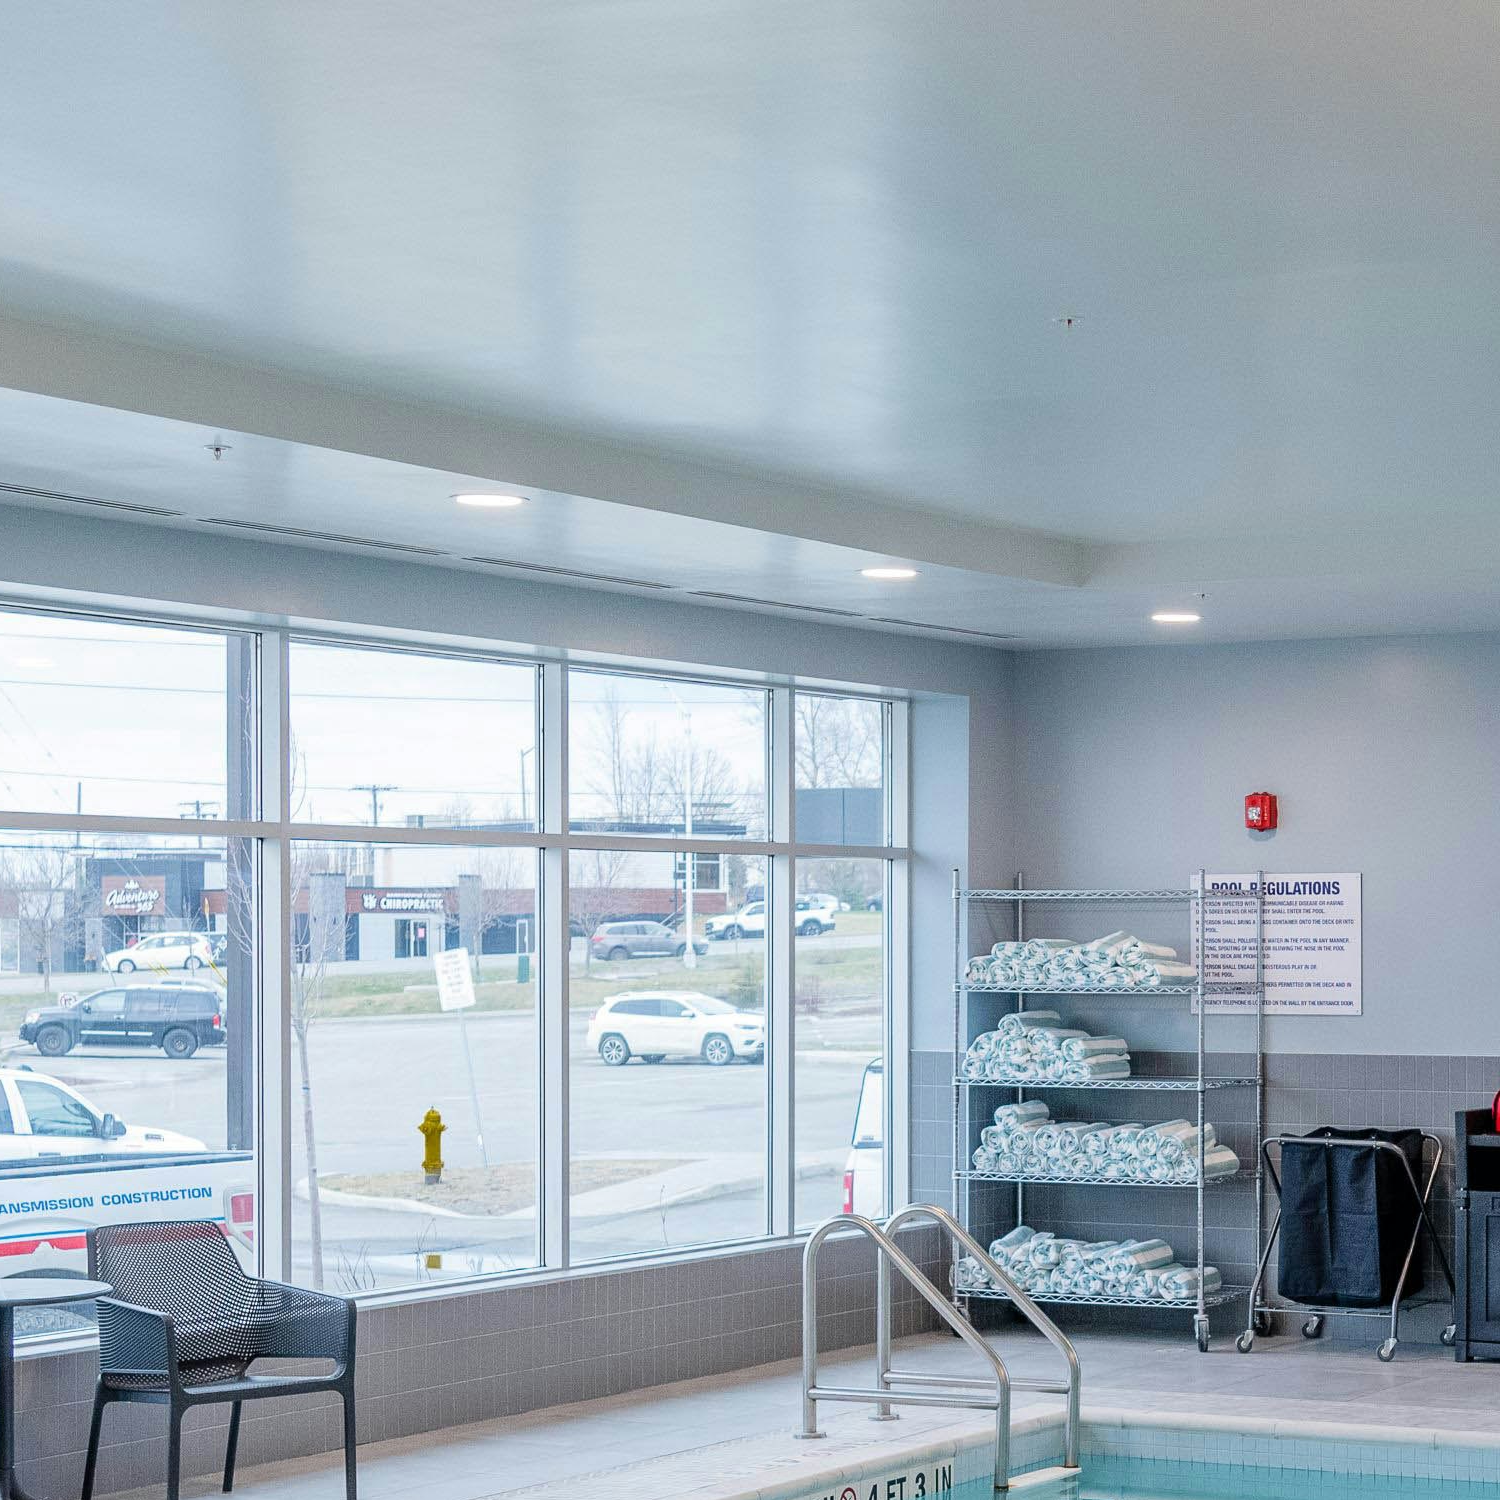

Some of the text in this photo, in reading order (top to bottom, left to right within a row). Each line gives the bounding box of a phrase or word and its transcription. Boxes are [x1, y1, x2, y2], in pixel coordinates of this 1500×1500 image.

[380, 896, 444, 910] CHIROPRACTIC
[101, 1186, 213, 1207] CONSTRUCTION
[915, 1472, 926, 1498] 3
[935, 1464, 952, 1493] IN
